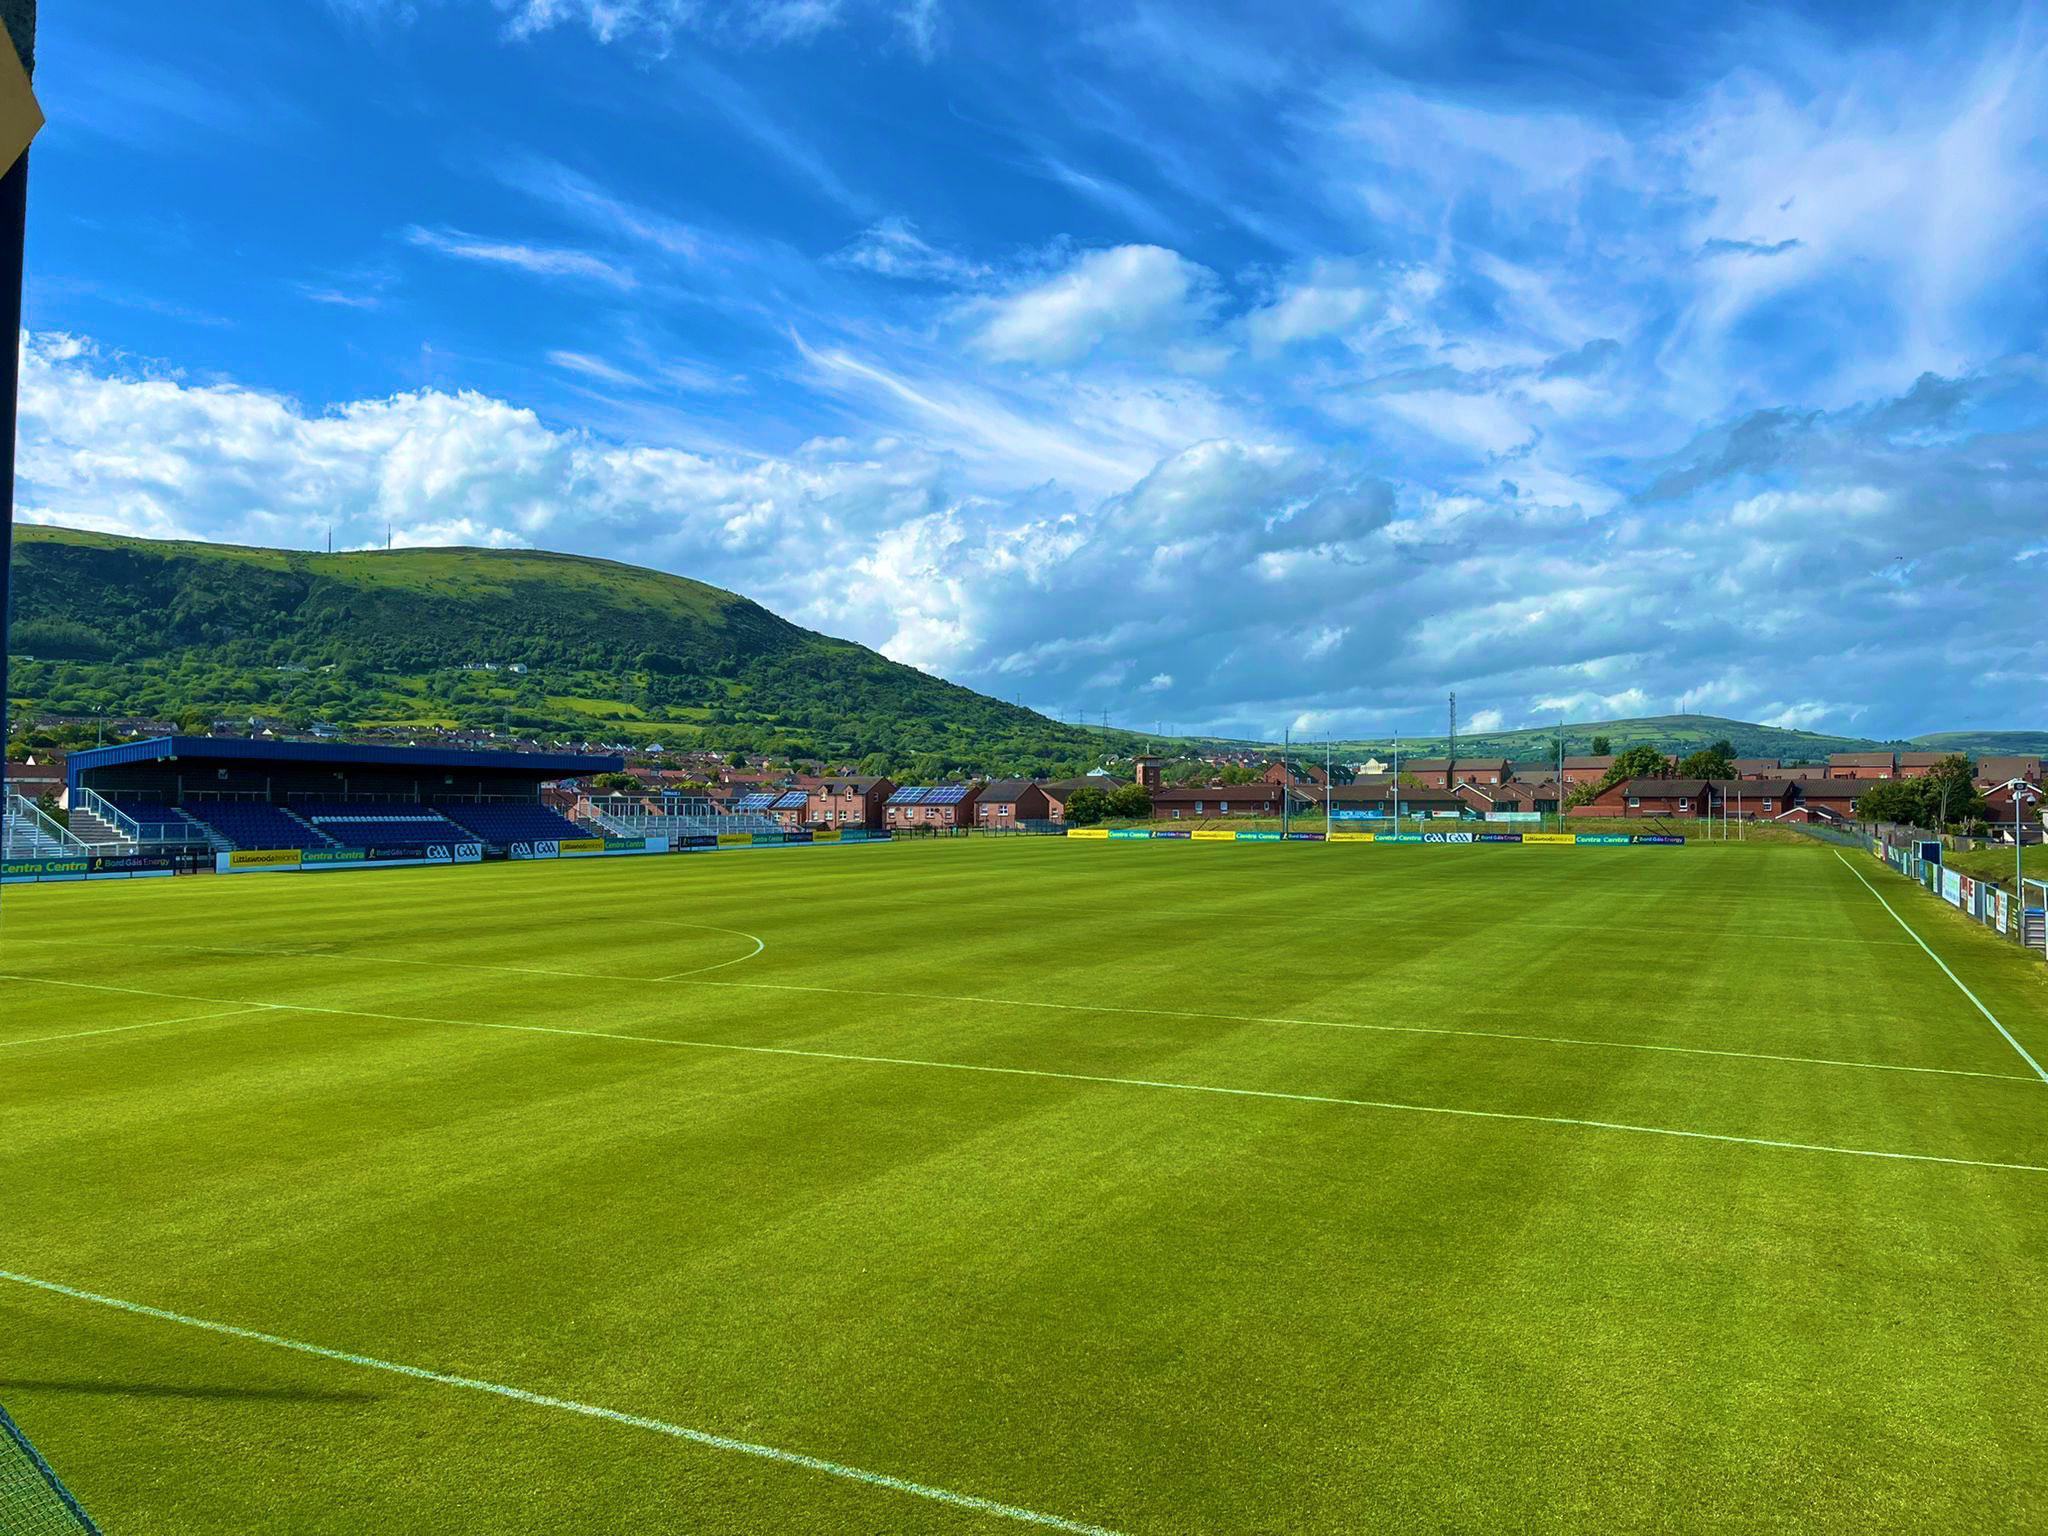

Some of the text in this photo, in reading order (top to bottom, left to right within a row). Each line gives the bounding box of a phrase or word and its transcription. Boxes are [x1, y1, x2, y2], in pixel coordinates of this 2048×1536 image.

[302, 851, 365, 860] Centra Centra
[105, 859, 124, 867] Bord
[143, 857, 169, 866] Energy
[0, 862, 88, 873] Centra Centra
